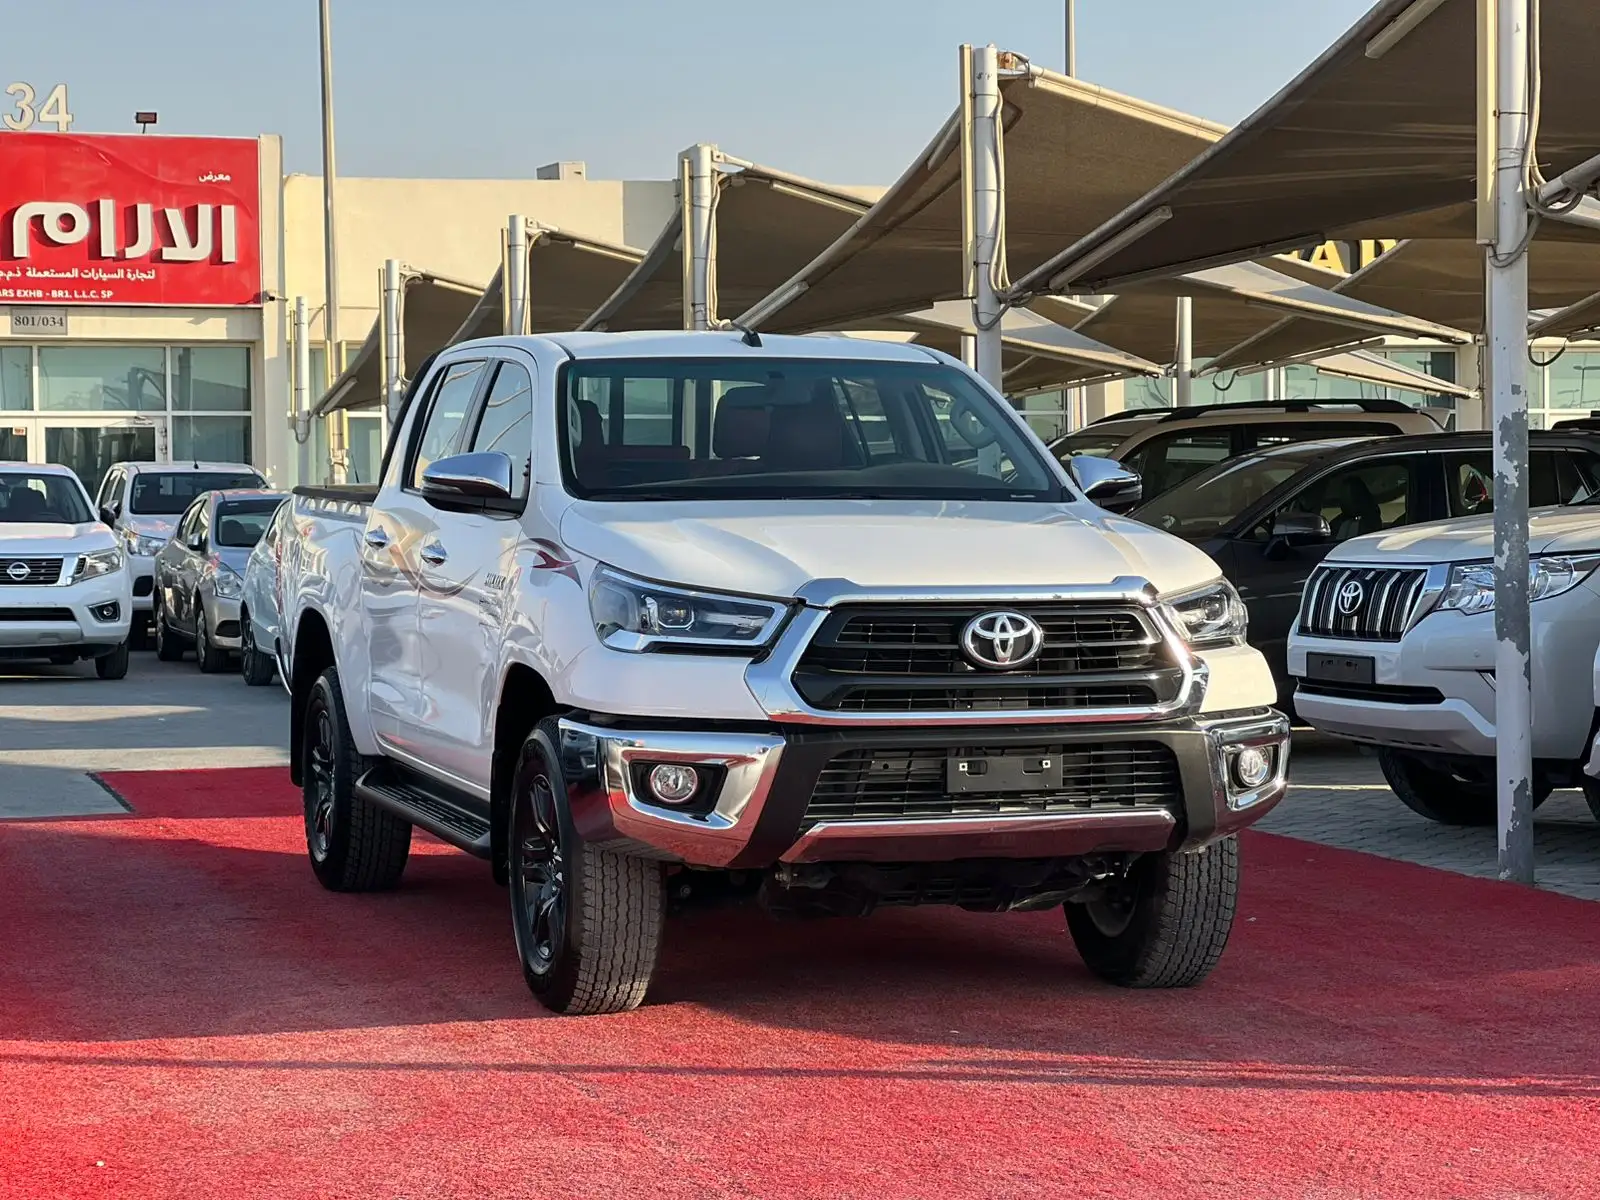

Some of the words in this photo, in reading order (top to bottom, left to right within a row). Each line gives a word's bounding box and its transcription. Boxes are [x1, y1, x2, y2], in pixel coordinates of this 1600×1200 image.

[2, 81, 73, 131] 34
[198, 170, 231, 183] معرض
[25, 266, 79, 279] المستعملة
[80, 267, 125, 282] السيارات
[126, 268, 156, 282] لتجارة
[16, 288, 43, 298] EXHB
[100, 289, 114, 299] SP
[14, 315, 64, 327] 801/034
